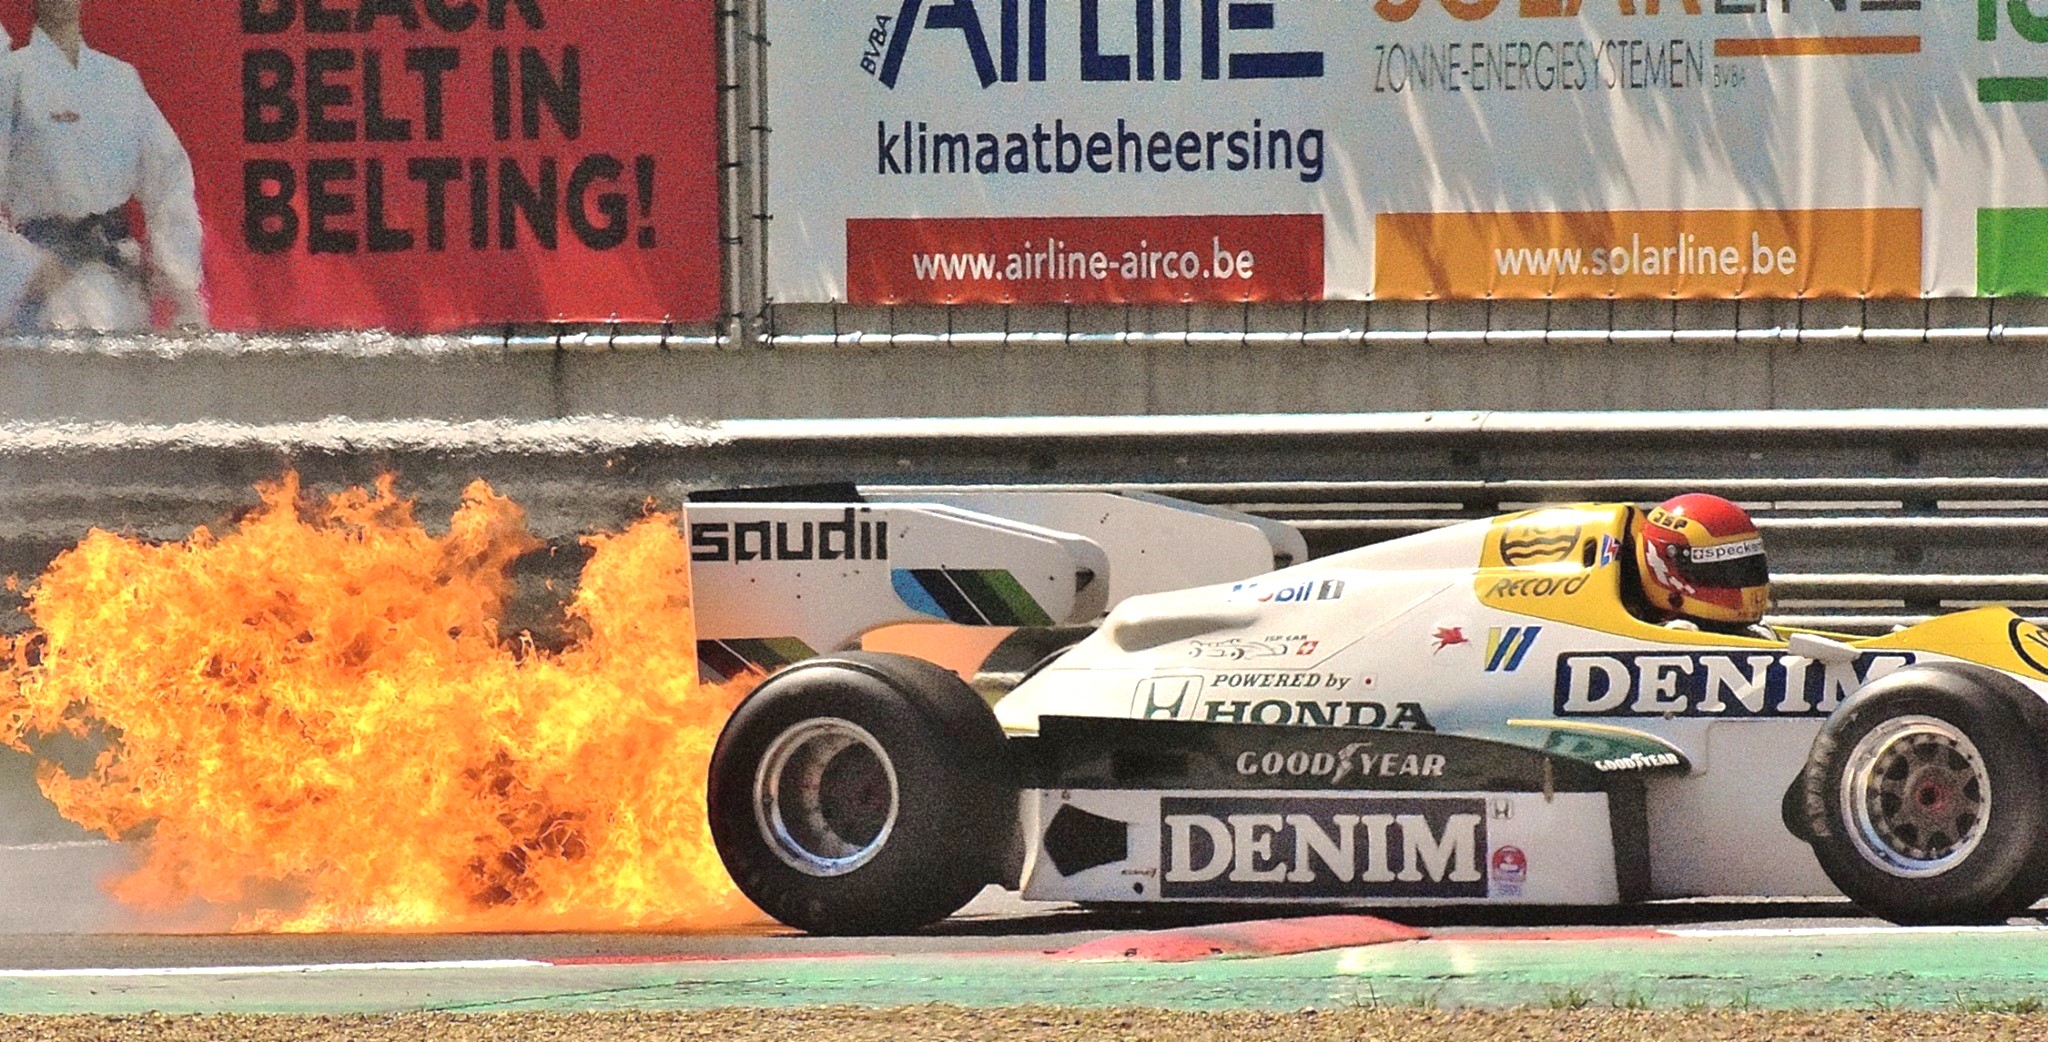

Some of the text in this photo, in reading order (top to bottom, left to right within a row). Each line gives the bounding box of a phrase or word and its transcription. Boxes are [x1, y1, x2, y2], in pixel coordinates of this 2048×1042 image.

[860, 14, 893, 76] BVBA
[1374, 39, 1704, 93] ZONNE-ENERGIESYSTEMEN
[242, 44, 582, 143] BELT IN
[877, 118, 1324, 183] klimaatbeheersing
[242, 153, 657, 254] BELTING!
[912, 236, 1255, 281] www.airline-airco.be
[1494, 231, 1797, 276] www.solarline.be
[1210, 673, 1351, 690] POWERED by
[1203, 699, 1436, 732] HONDA
[1164, 813, 1482, 883] DENIM
